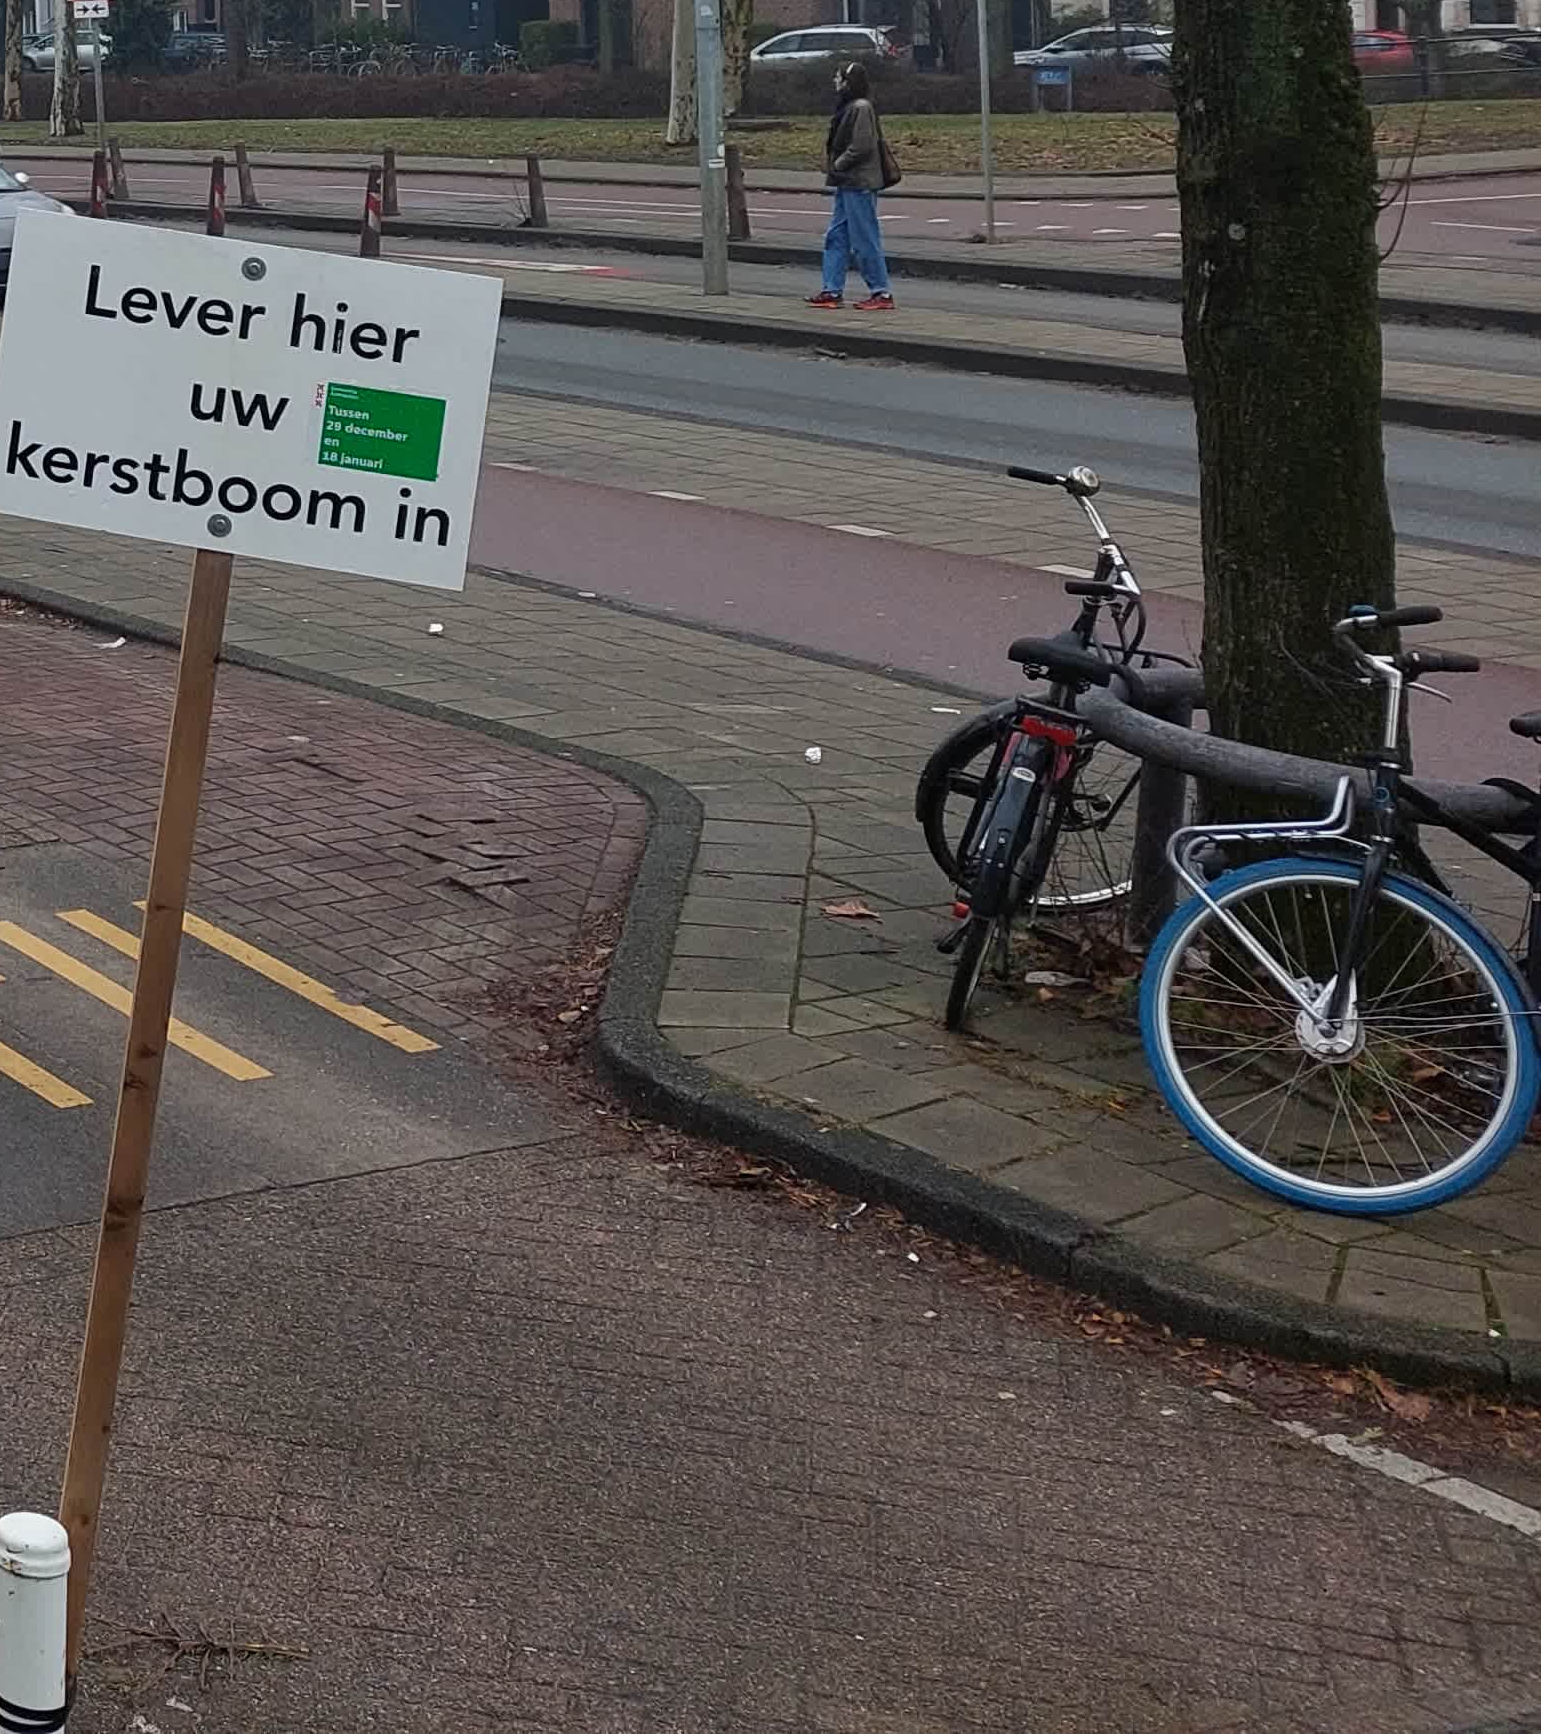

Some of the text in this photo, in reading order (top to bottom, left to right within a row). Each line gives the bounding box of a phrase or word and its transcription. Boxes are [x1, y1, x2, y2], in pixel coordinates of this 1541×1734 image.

[84, 264, 420, 364] Lever hier
[189, 383, 291, 431] uw
[328, 405, 370, 420] Tussen
[325, 420, 409, 442] 29 december
[324, 438, 340, 447] en
[322, 451, 384, 469] 18 januari
[5, 419, 450, 547] kerstboom in
